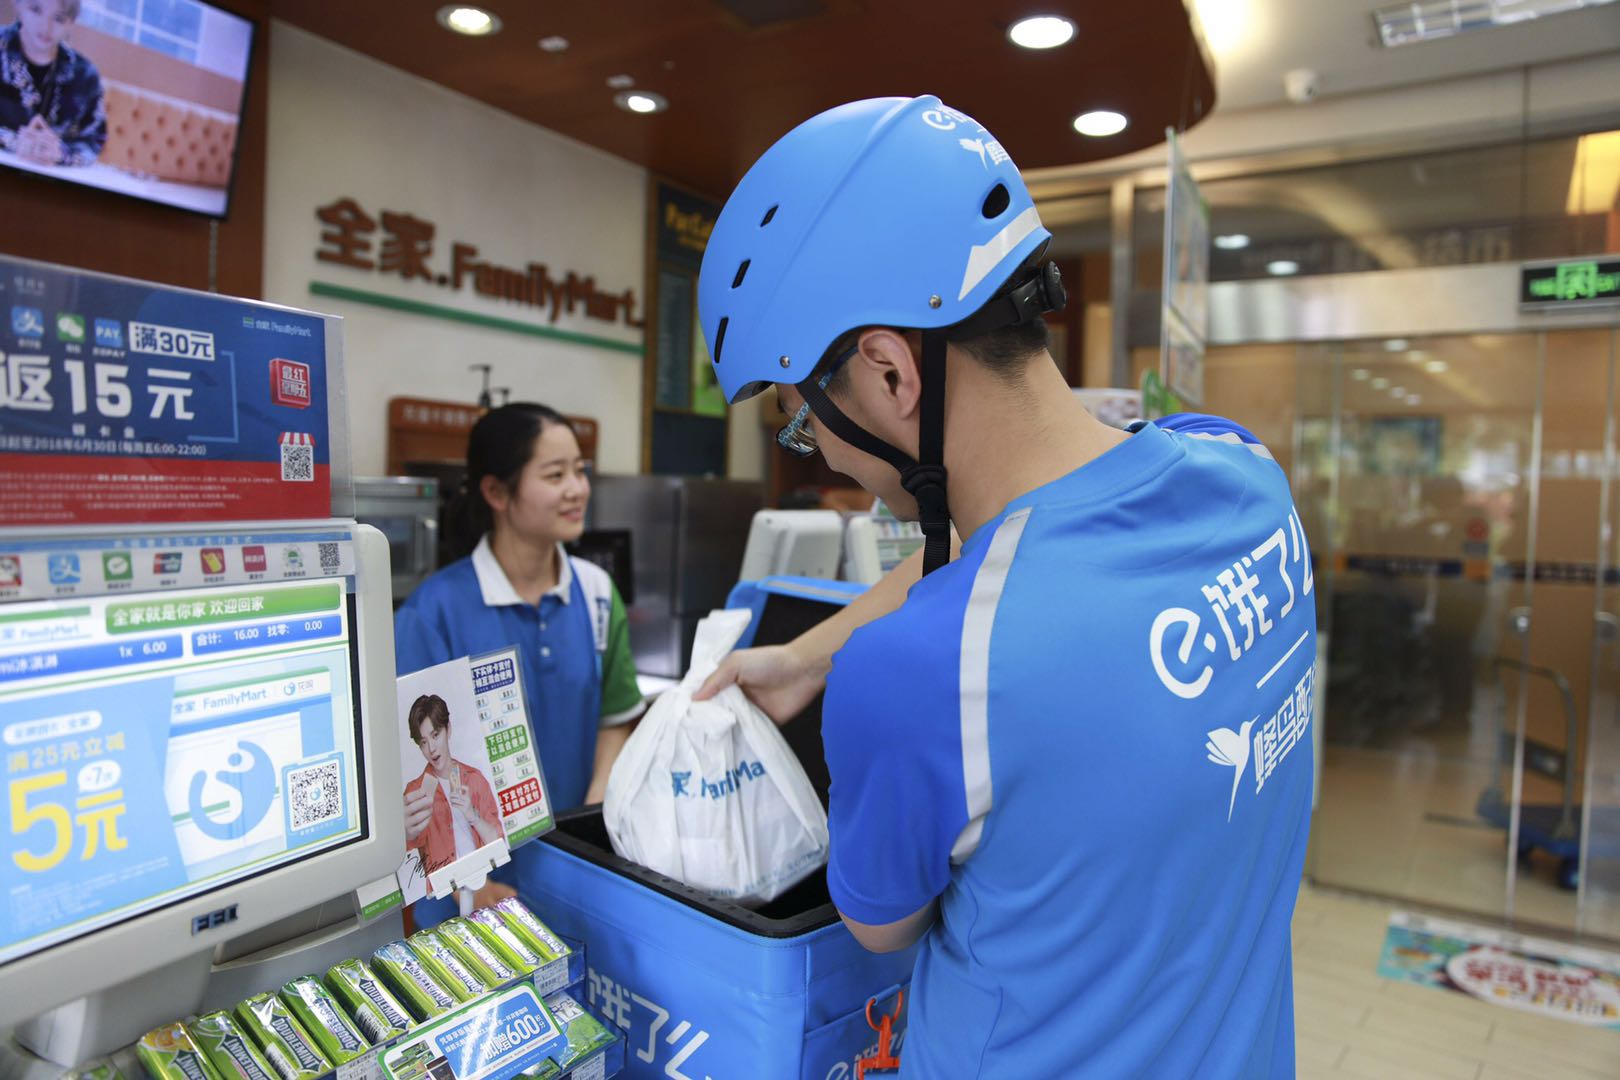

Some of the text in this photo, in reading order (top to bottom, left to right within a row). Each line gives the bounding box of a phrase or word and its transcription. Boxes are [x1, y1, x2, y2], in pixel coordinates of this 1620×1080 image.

[135, 325, 212, 358] 满30元
[0, 350, 195, 421] 返15元
[143, 640, 167, 655] 6.00
[233, 628, 259, 641] 16.00
[304, 620, 322, 632] 0.00
[362, 981, 403, 1027] DOUBLEMINT
[271, 1017, 318, 1069] DOUBLEMINT
